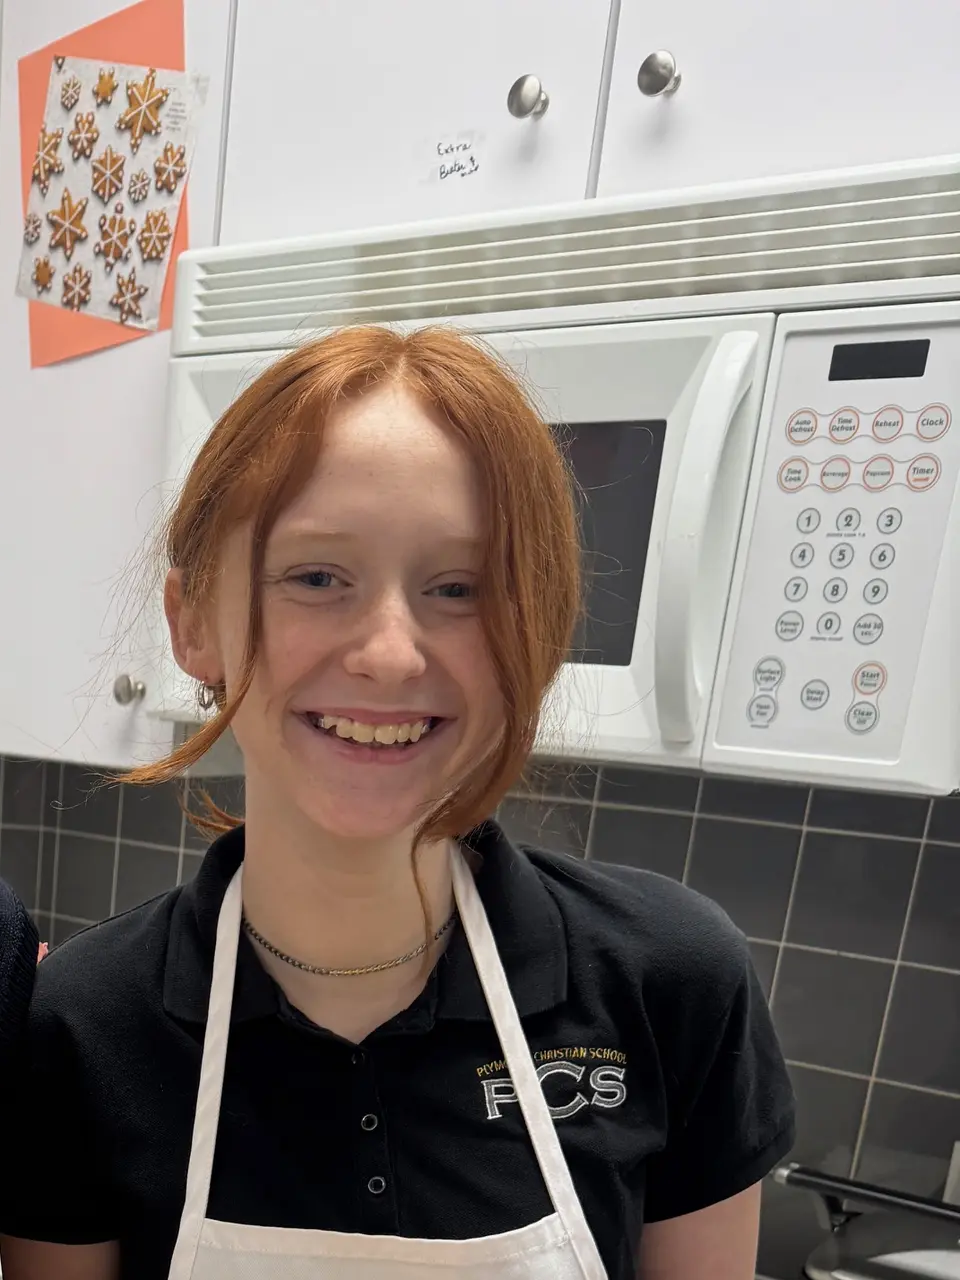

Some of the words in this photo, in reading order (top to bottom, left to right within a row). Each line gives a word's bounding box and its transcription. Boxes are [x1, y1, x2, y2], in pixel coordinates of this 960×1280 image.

[837, 417, 853, 425] Time
[874, 419, 900, 428] Reheat
[921, 418, 945, 427] Clock
[831, 424, 856, 432] Defrost
[912, 467, 934, 475] Timer
[805, 514, 812, 528] 1
[844, 514, 853, 527] 2
[885, 514, 894, 528] 3
[799, 548, 806, 561] 4
[837, 549, 846, 562] 5
[878, 549, 887, 562] 6
[792, 583, 801, 596] 7
[831, 584, 840, 597] 8
[871, 585, 880, 598] 9
[824, 618, 833, 631] 0
[476, 1060, 508, 1077] PLYM
[533, 1046, 587, 1061] CHRISTIAN
[589, 1047, 628, 1064] SCHOOL
[481, 1060, 628, 1120] PCS
